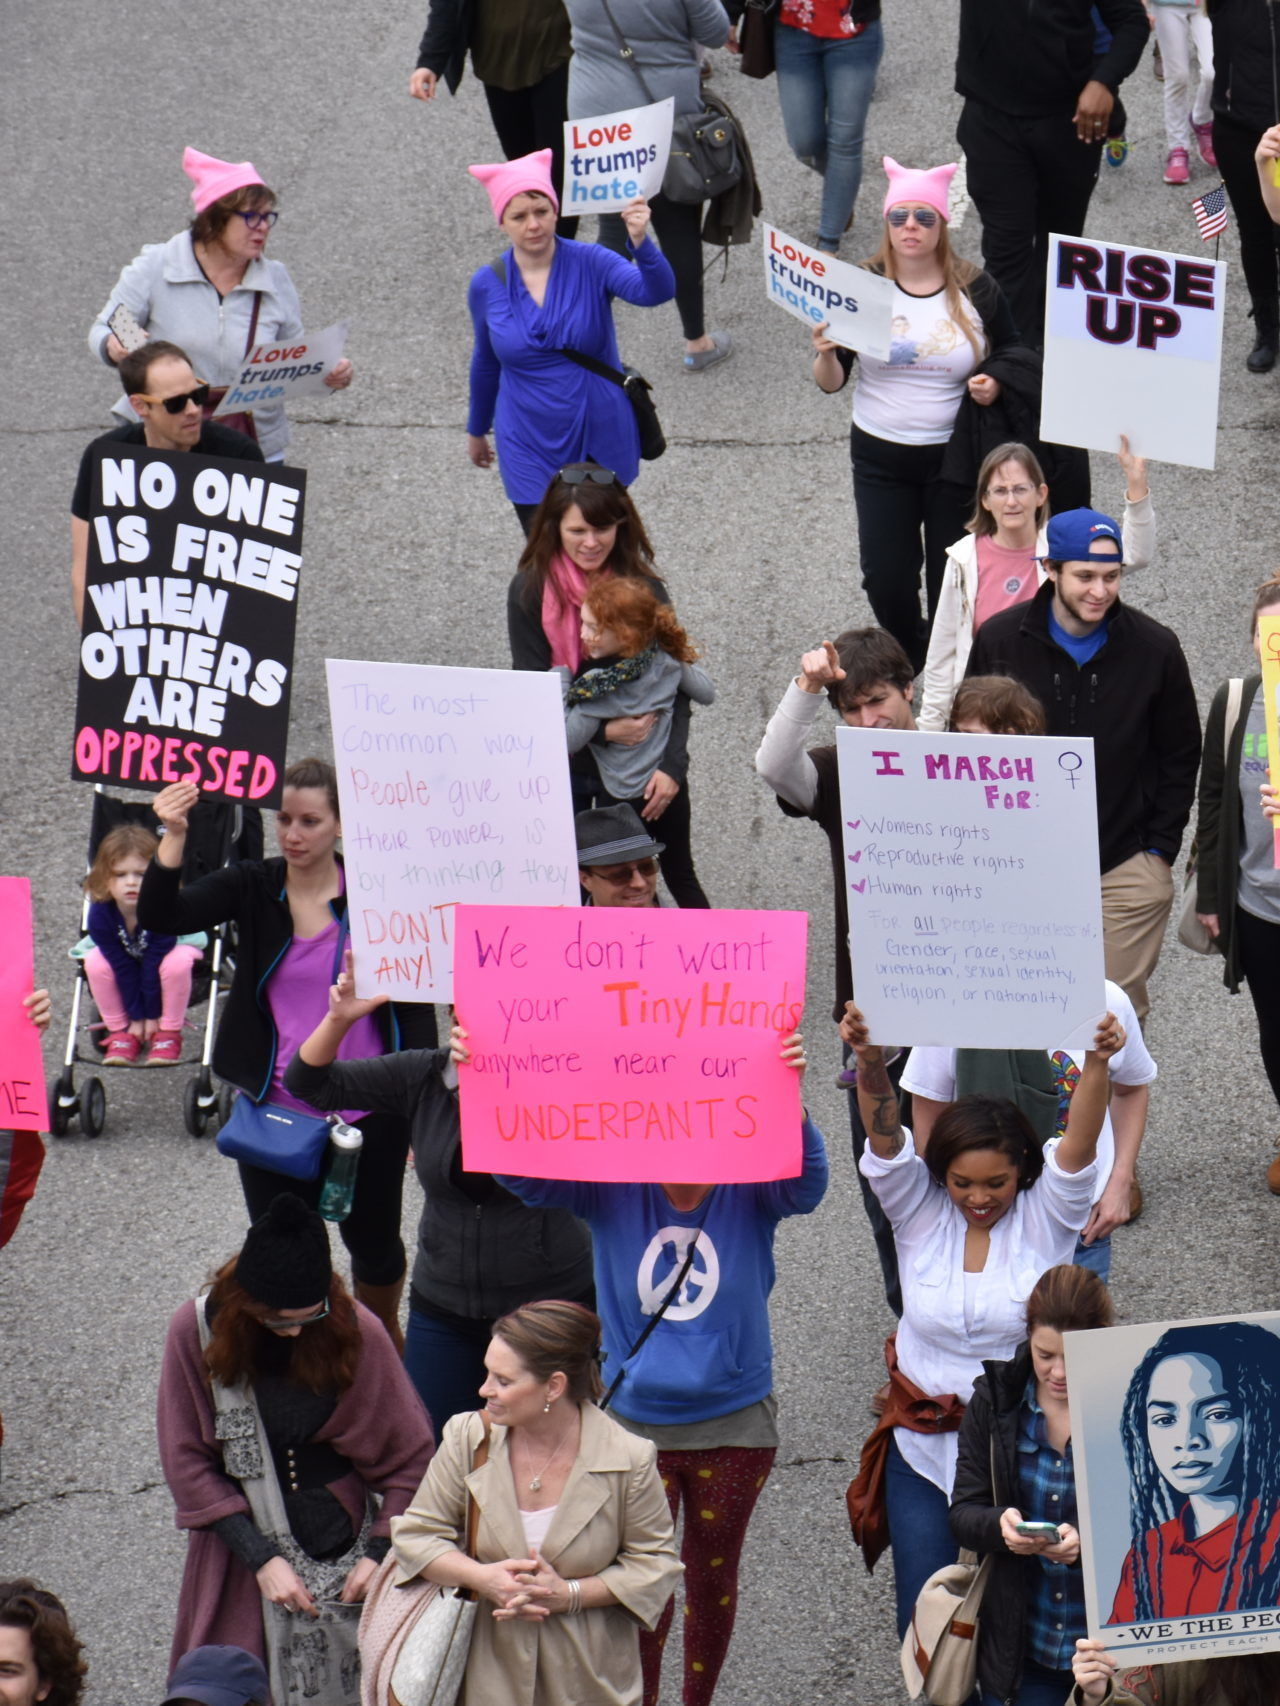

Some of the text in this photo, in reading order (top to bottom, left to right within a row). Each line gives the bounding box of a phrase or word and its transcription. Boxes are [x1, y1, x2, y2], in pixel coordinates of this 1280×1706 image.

[572, 122, 632, 149] Love
[571, 144, 657, 176] trumps
[770, 231, 826, 277] Love
[1056, 240, 1215, 310] RISE
[769, 254, 859, 313] trumps
[1086, 293, 1181, 350] UP
[240, 361, 324, 385] trumps
[250, 345, 307, 364] Love
[101, 458, 300, 536] NO ONE
[93, 515, 303, 601] IS FREE
[88, 576, 228, 637] WHEN
[80, 628, 287, 707] OTHERS
[123, 677, 227, 737] ARE
[342, 683, 489, 717] The most
[75, 726, 277, 799] OPPRESSED
[484, 734, 535, 768] way
[872, 751, 1034, 783] I MARCH
[350, 766, 551, 818] People give up
[984, 785, 1040, 809] FOR:
[860, 815, 991, 850] Womens rights
[355, 858, 570, 901] by thinking they
[863, 842, 1025, 875] Reproductive rights
[868, 875, 983, 903] Human rights
[362, 901, 461, 946] DON'T
[913, 915, 935, 931] all
[940, 916, 995, 937] people
[1001, 919, 1076, 942] regardless
[375, 946, 435, 989] ANY!
[475, 920, 773, 975] We don't want
[886, 938, 1056, 964] Gender, race, sexual
[964, 963, 1010, 979] sexual
[1016, 965, 1077, 983] identity,
[498, 981, 802, 1044] your Tiny Hands
[962, 989, 979, 1000] or
[984, 988, 1070, 1013] nationality
[473, 1044, 747, 1089] anywhere near our
[496, 1095, 758, 1142] UNDERPANTS
[1128, 1624, 1173, 1641] WE
[1180, 1617, 1233, 1636] THE
[1147, 1640, 1219, 1655] PROTECT
[1228, 1635, 1270, 1646] EACH
